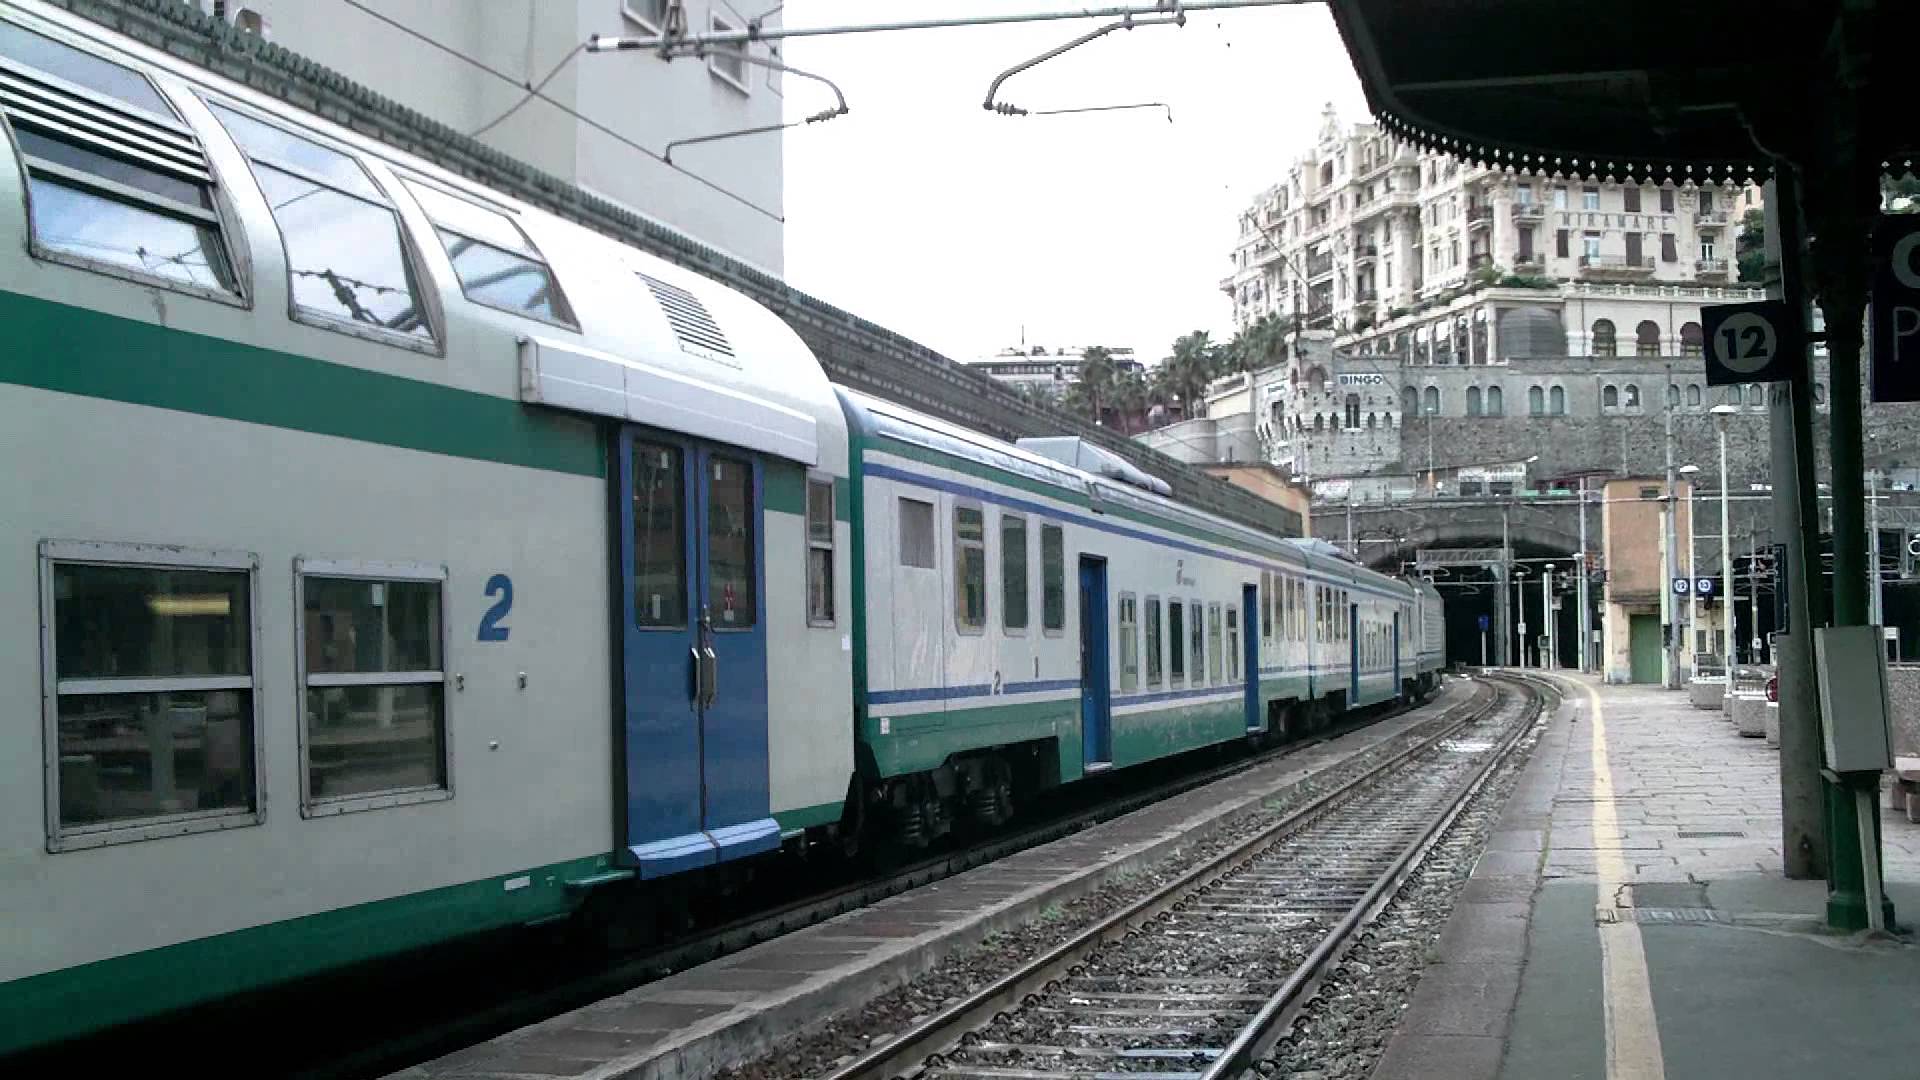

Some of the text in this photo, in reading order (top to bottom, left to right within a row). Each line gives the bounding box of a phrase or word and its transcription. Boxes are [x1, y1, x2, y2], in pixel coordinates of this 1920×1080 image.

[1562, 212, 1668, 230] MIRAMARE
[1721, 325, 1768, 360] 12
[1340, 375, 1382, 385] BINGO
[478, 574, 513, 641] 2
[993, 670, 1001, 696] 2
